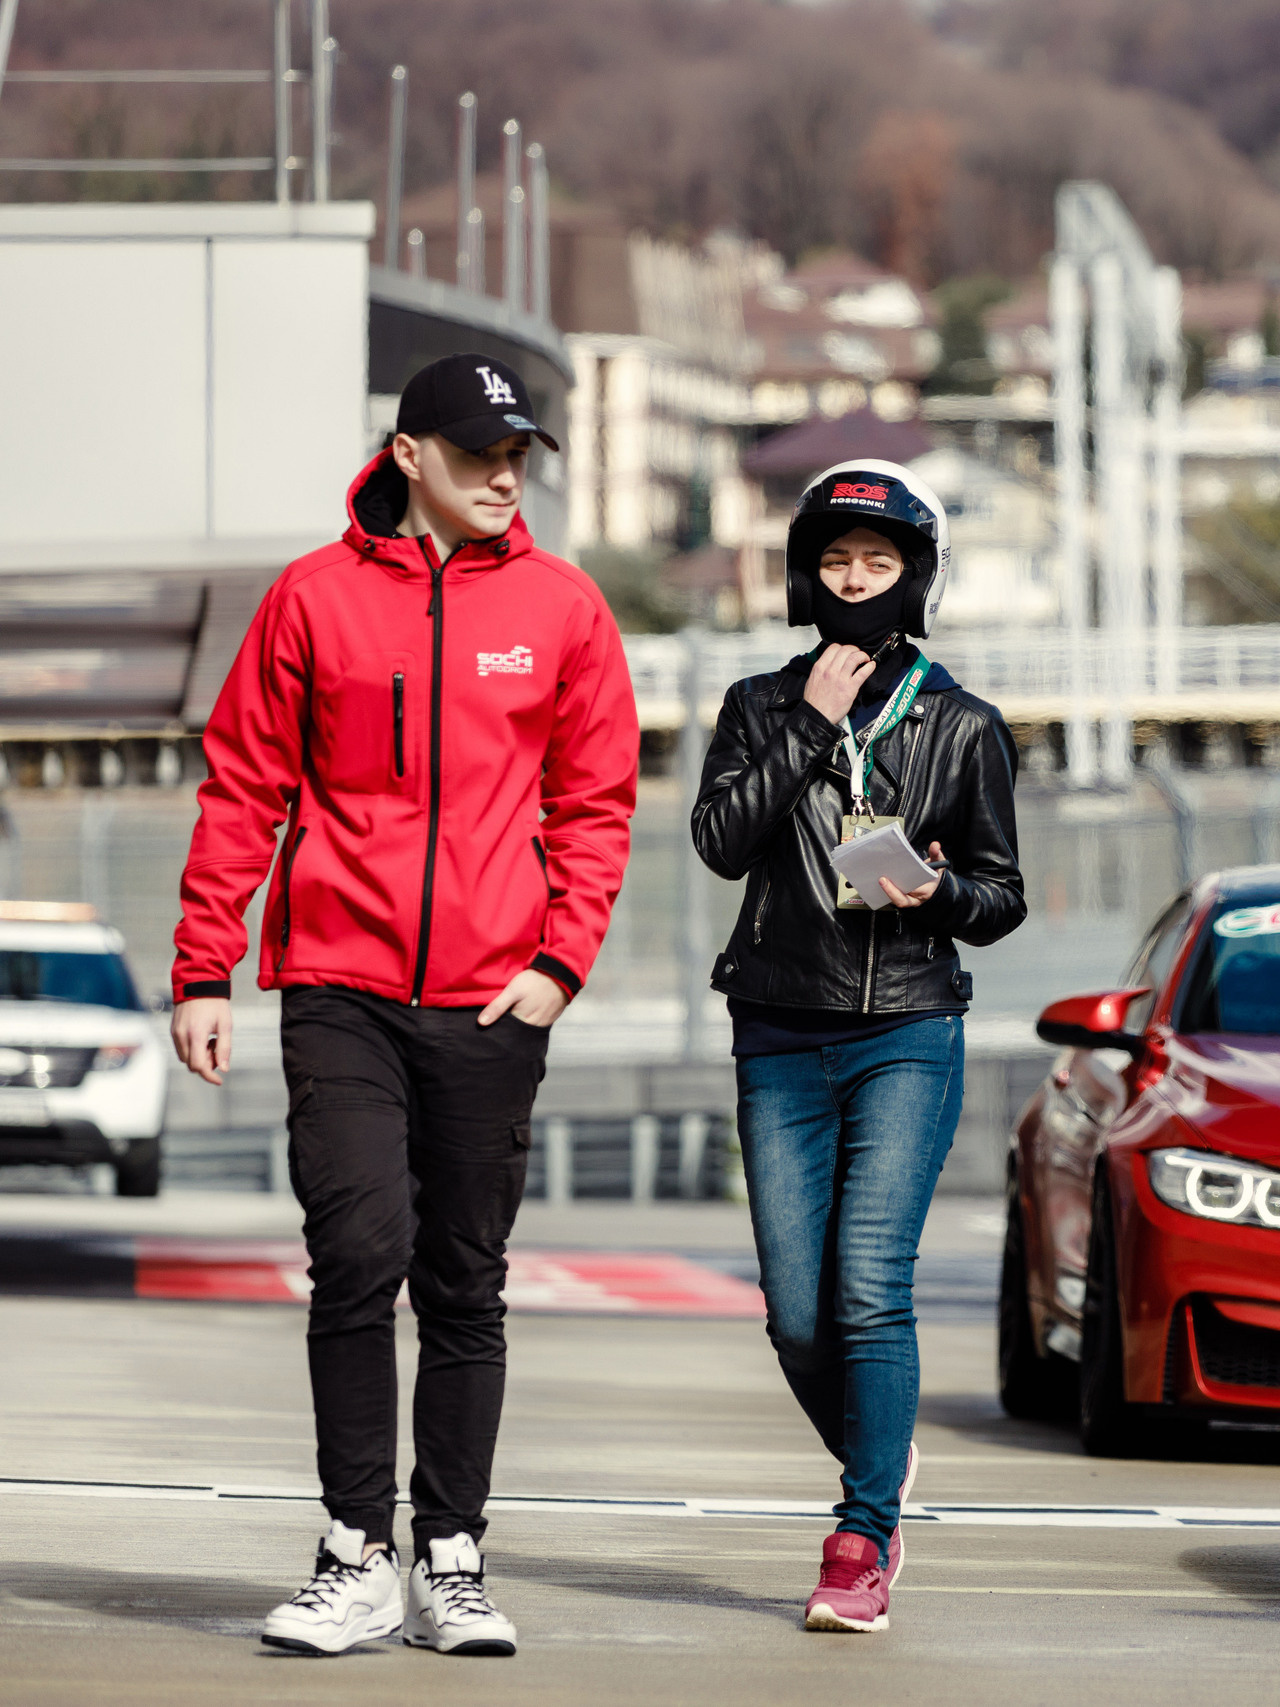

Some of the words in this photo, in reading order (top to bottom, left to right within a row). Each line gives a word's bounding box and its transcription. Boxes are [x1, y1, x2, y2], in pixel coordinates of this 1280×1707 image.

[476, 366, 517, 404] LA
[832, 483, 887, 500] ROS
[477, 653, 533, 666] SOCHI
[896, 685, 914, 717] EDGE
